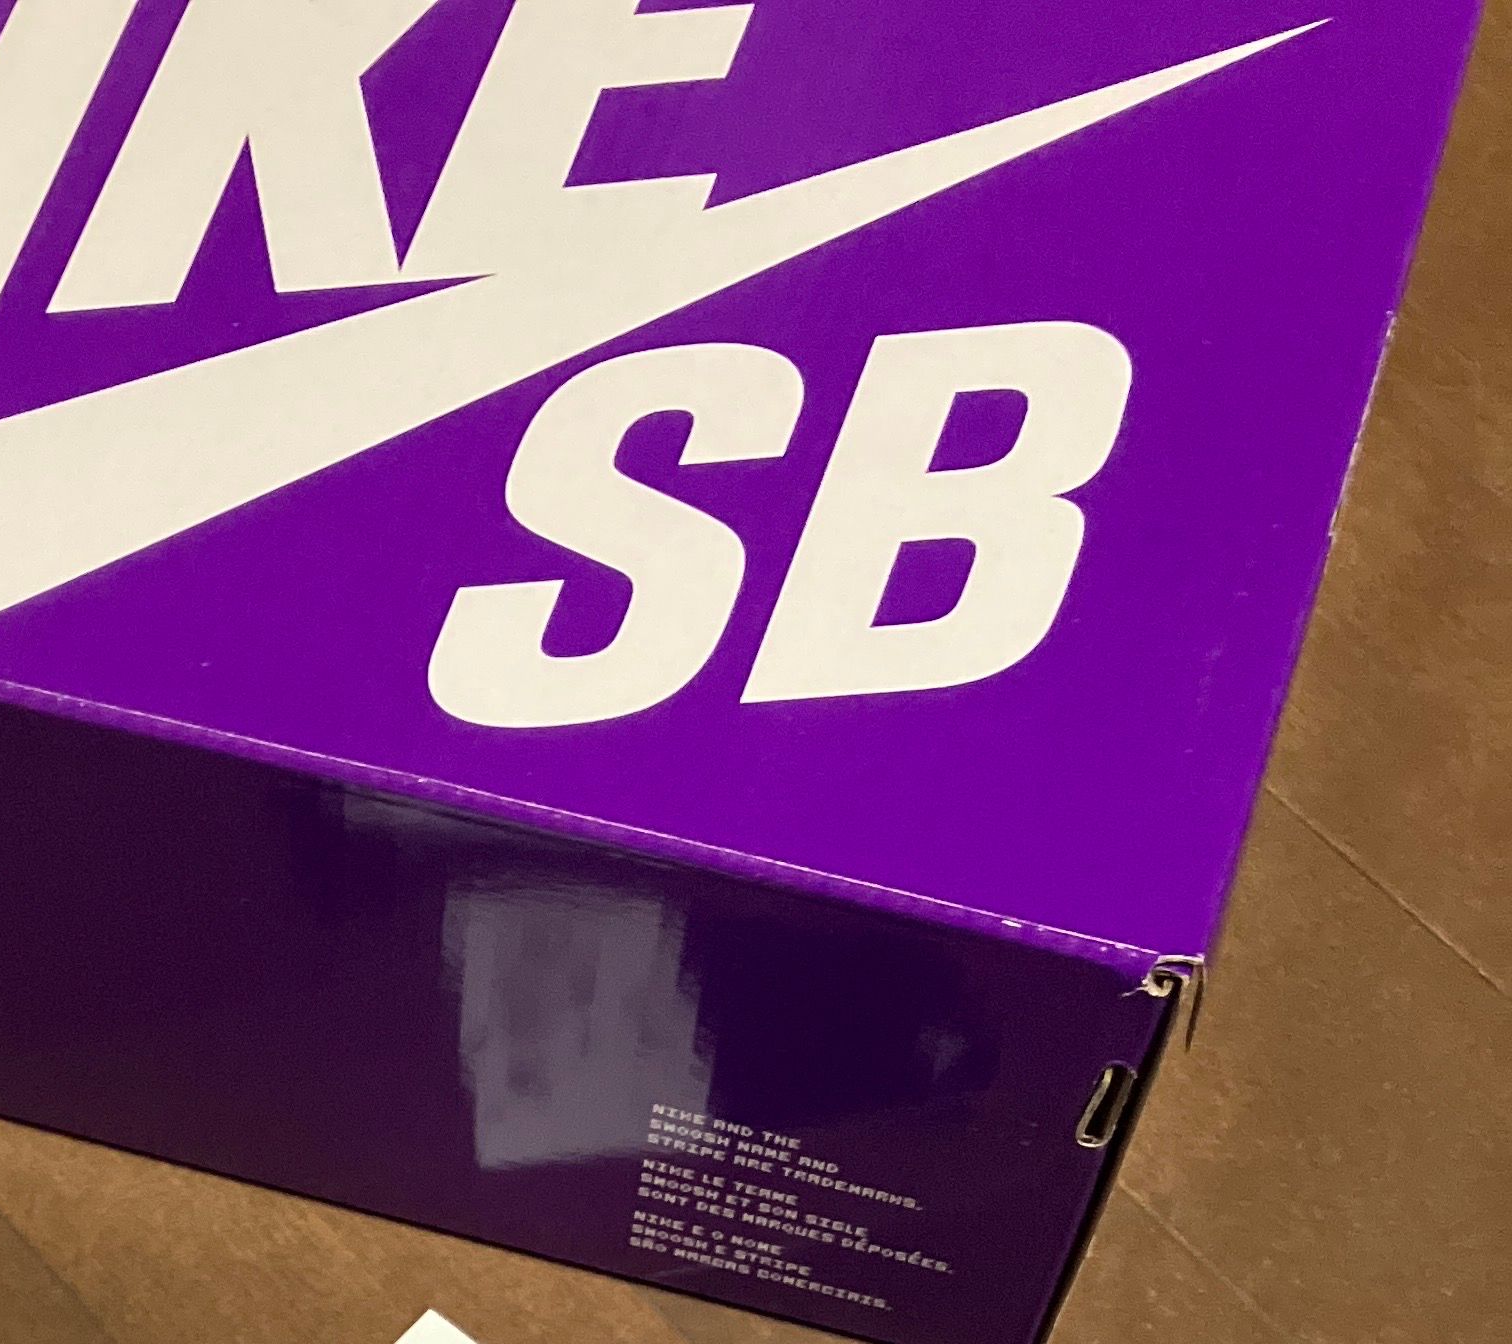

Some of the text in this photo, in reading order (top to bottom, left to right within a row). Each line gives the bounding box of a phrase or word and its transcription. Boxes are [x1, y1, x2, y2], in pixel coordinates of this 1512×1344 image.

[427, 320, 1133, 729] SB
[651, 1102, 802, 1151] NIKE AND THE
[646, 1132, 727, 1162] STRIPE
[732, 1153, 774, 1174] ARE
[736, 1139, 792, 1163] NAME
[797, 1155, 840, 1175] AND
[641, 1157, 696, 1181] NIKE
[701, 1173, 726, 1189] LE
[694, 1199, 736, 1220] DES
[724, 1193, 752, 1209] ET
[757, 1201, 798, 1221] SON
